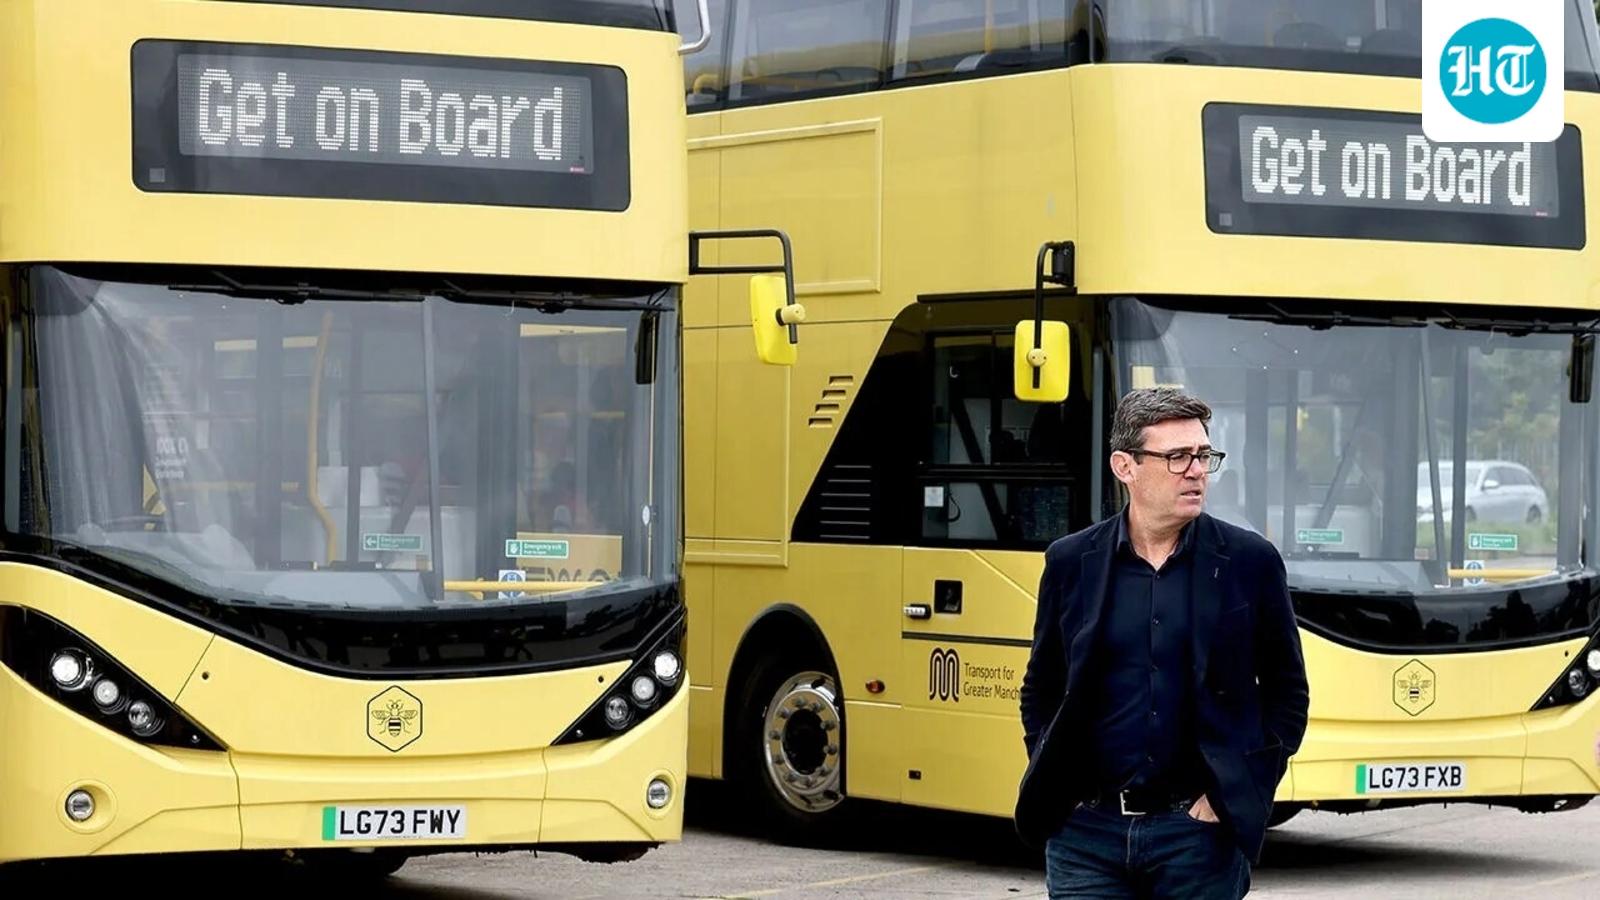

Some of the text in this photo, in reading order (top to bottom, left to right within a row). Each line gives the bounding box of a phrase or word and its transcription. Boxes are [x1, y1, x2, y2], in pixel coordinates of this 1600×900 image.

[199, 68, 563, 161] Get on Board
[1252, 126, 1532, 206] Get on Board
[964, 662, 1014, 682] Transport for
[963, 681, 992, 698] Greater
[1369, 766, 1461, 789] LG73 FXB
[340, 809, 461, 835] LG73 FWY
